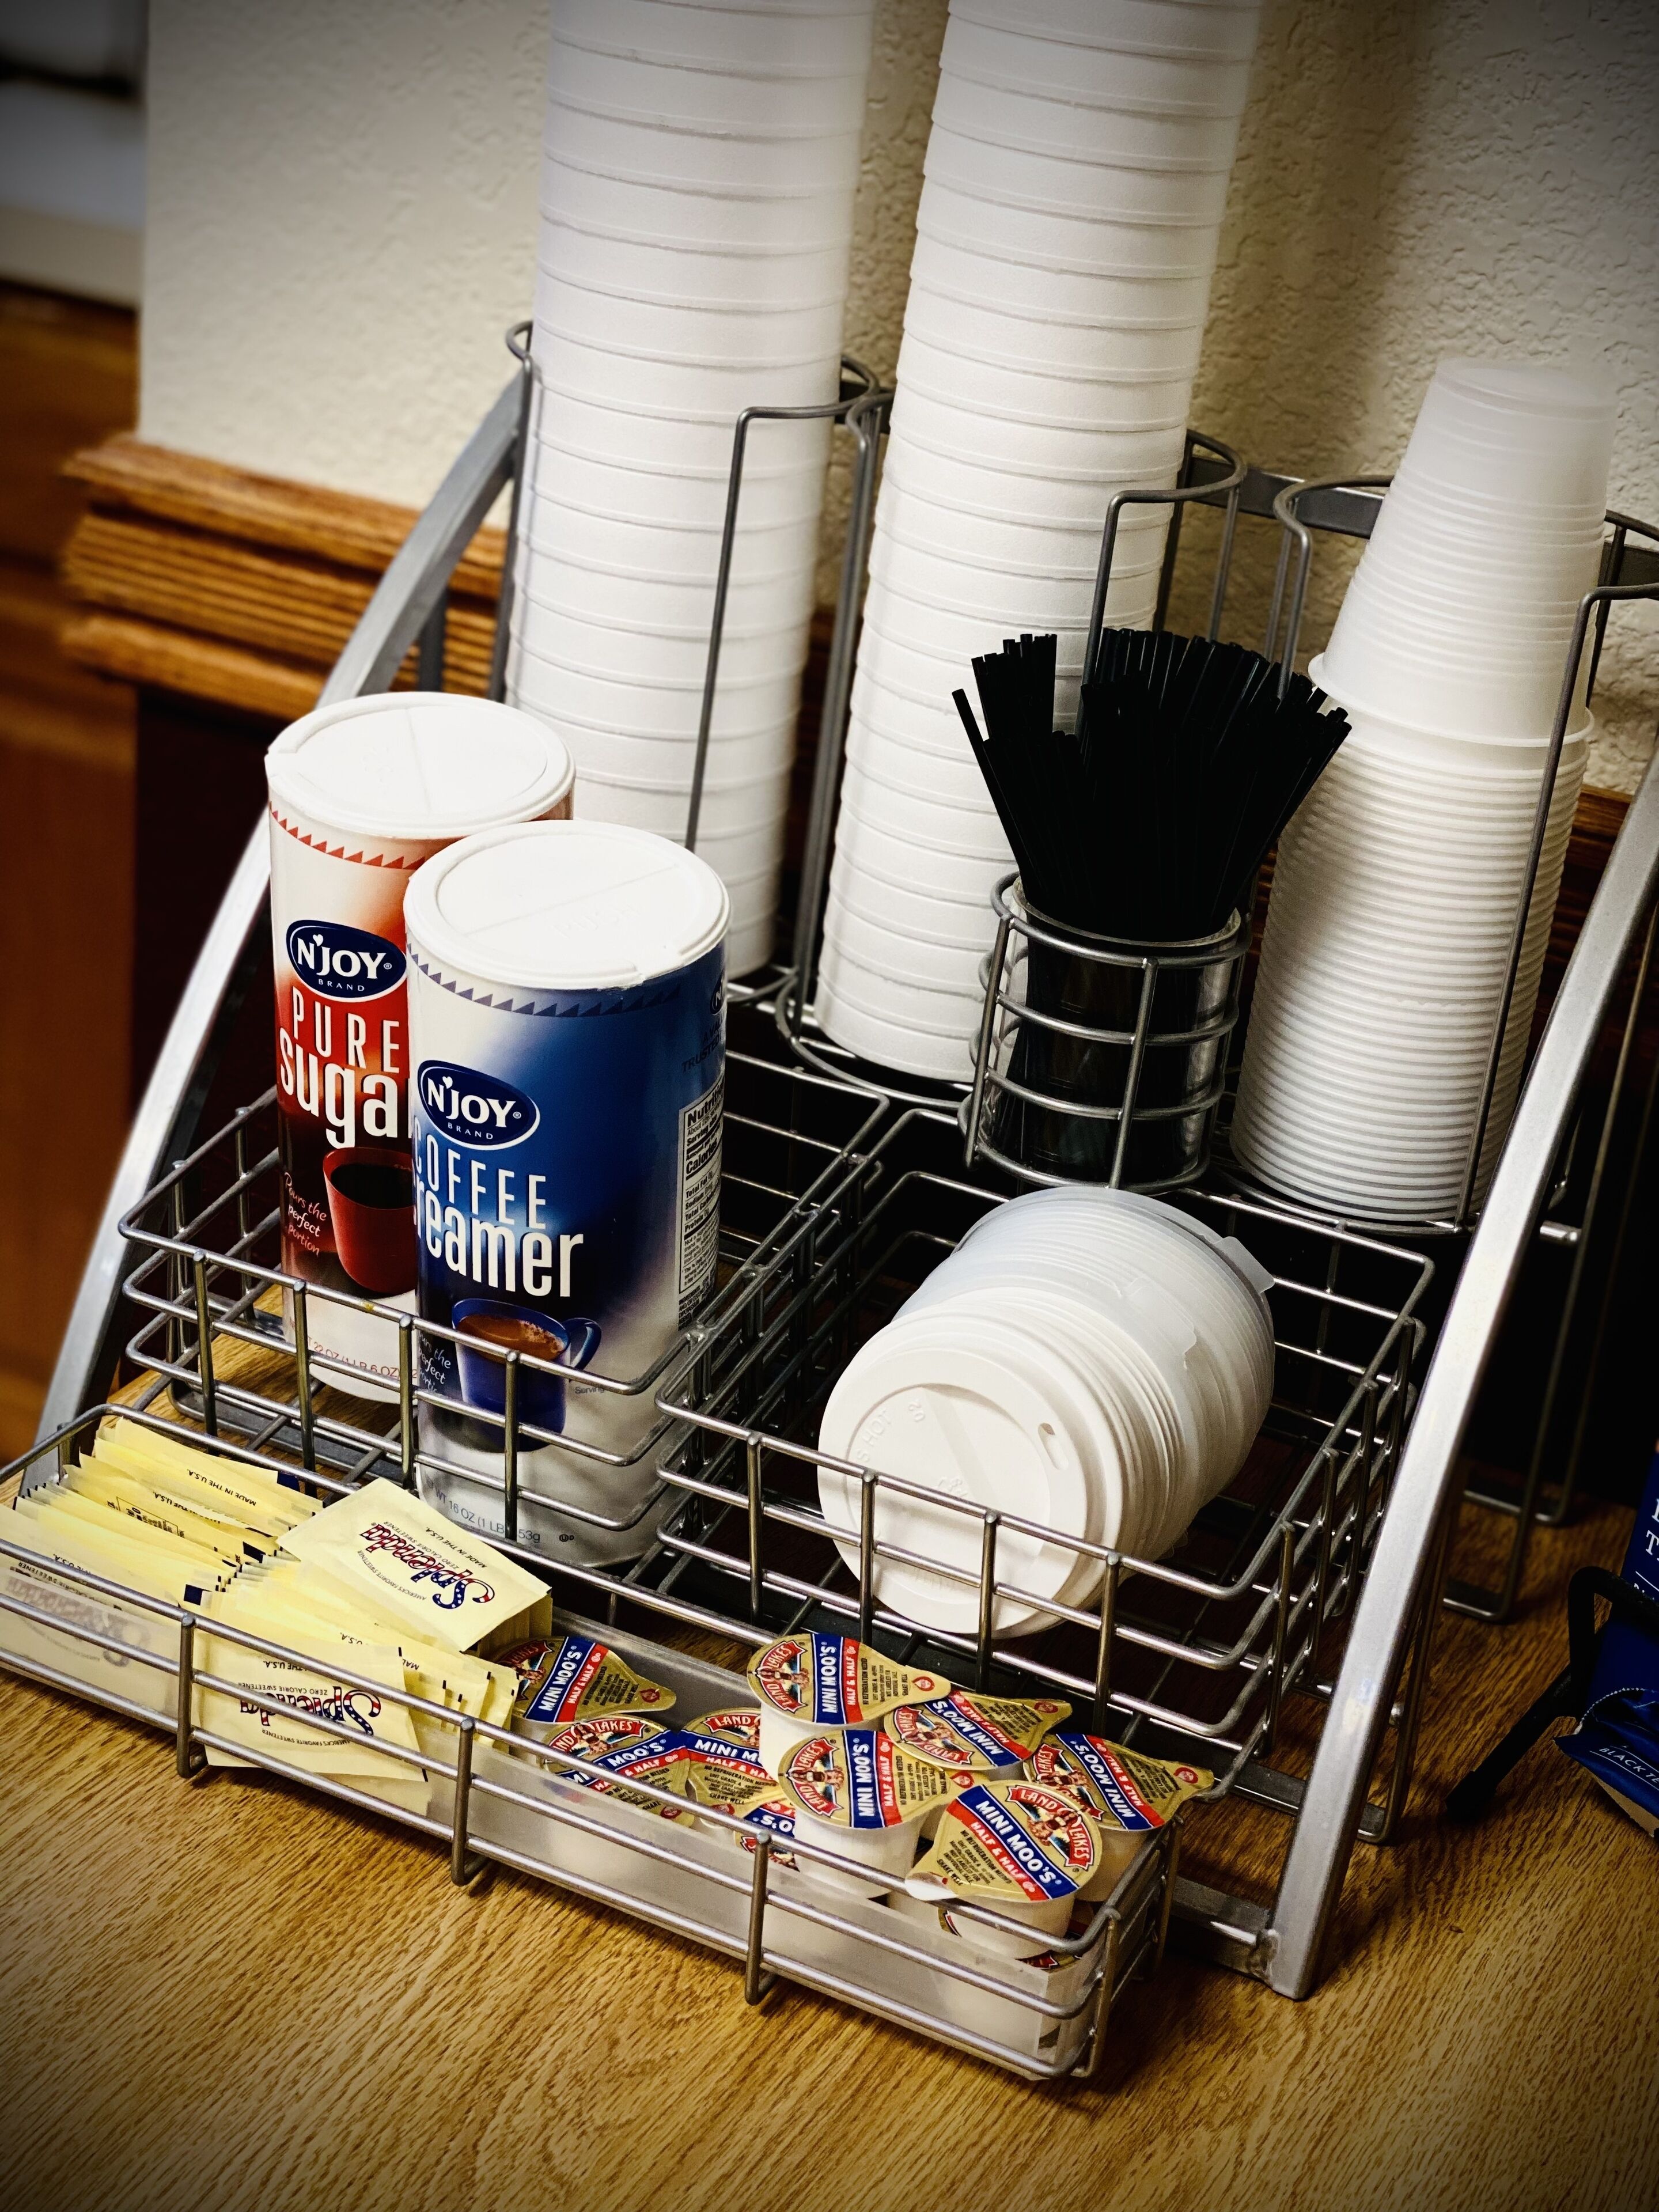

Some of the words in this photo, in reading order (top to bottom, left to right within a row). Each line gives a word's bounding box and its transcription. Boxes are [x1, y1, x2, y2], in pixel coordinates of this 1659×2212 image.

[318, 978, 365, 991] BRAND
[293, 986, 400, 1074] PURE
[448, 1122, 494, 1139] BRAND
[415, 1116, 546, 1229] COFFEE
[285, 1172, 306, 1208] Pours
[308, 1202, 327, 1221] the
[289, 1204, 321, 1237] perfect
[288, 1224, 320, 1256] portion
[434, 1349, 451, 1369] the
[208, 1480, 223, 1491] THE
[225, 1488, 233, 1496] IN
[235, 1493, 256, 1506] MADE
[384, 1521, 416, 1543] SWEETENER
[449, 1501, 459, 1513] 16
[461, 1508, 475, 1524] OZ
[518, 1531, 540, 1543] 53g
[416, 1542, 441, 1559] CALORIE
[442, 1539, 457, 1551] THE
[459, 1548, 467, 1556] IN
[358, 1550, 377, 1573] SWEETENER
[359, 1524, 495, 1609] Splenda
[442, 1559, 459, 1569] ZERO
[465, 1554, 487, 1568] MADE
[377, 1571, 398, 1589] FAVORITE
[769, 1646, 793, 1669] LAKES
[821, 1646, 837, 1684] MOO'S
[847, 1656, 857, 1677] HALF
[279, 1685, 307, 1694] CALORIE
[538, 1688, 559, 1711] MINI
[554, 1650, 583, 1684] MOO'S
[567, 1686, 578, 1704] HALF
[583, 1664, 595, 1681] HALF
[771, 1683, 790, 1706] LAND
[822, 1686, 838, 1713] MINI
[847, 1688, 857, 1706] HALF
[714, 1715, 751, 1726] LAND
[899, 1713, 918, 1735] LAKES
[932, 1700, 975, 1733] MOO'S
[961, 1706, 982, 1724] HALF
[262, 1729, 295, 1744] SWEETENER
[595, 1721, 633, 1733] LAKES
[987, 1725, 1010, 1744] HALF
[695, 1739, 738, 1758] MINI
[923, 1743, 959, 1760] LAND
[969, 1730, 1004, 1755] MINI
[607, 1742, 665, 1767] MOO'S
[706, 1756, 737, 1770] HALF
[738, 1764, 747, 1772] &
[802, 1743, 824, 1768] LAKES
[854, 1744, 872, 1783] MOO'S
[881, 1755, 891, 1776] HALF
[1037, 1750, 1054, 1773] LAKES
[1075, 1743, 1113, 1785] MOO'S
[1599, 1748, 1646, 1772] BLACK
[634, 1759, 661, 1773] HALF
[713, 1767, 754, 1783] REFRIGERATION
[800, 1785, 827, 1809] LAND
[858, 1787, 875, 1816] MINI
[883, 1789, 893, 1807] HALF
[1107, 1788, 1136, 1818] MINI
[1123, 1785, 1144, 1806] HALF
[1020, 1790, 1058, 1810] LAND
[1069, 1827, 1090, 1860] LAKES
[966, 1836, 997, 1870] REFRIGERATION
[969, 1821, 994, 1846] HALF
[993, 1848, 1001, 1856] &
[999, 1856, 1026, 1880] HALF
[975, 1800, 1014, 1836] MINI
[1007, 1834, 1057, 1884] MOO'S
